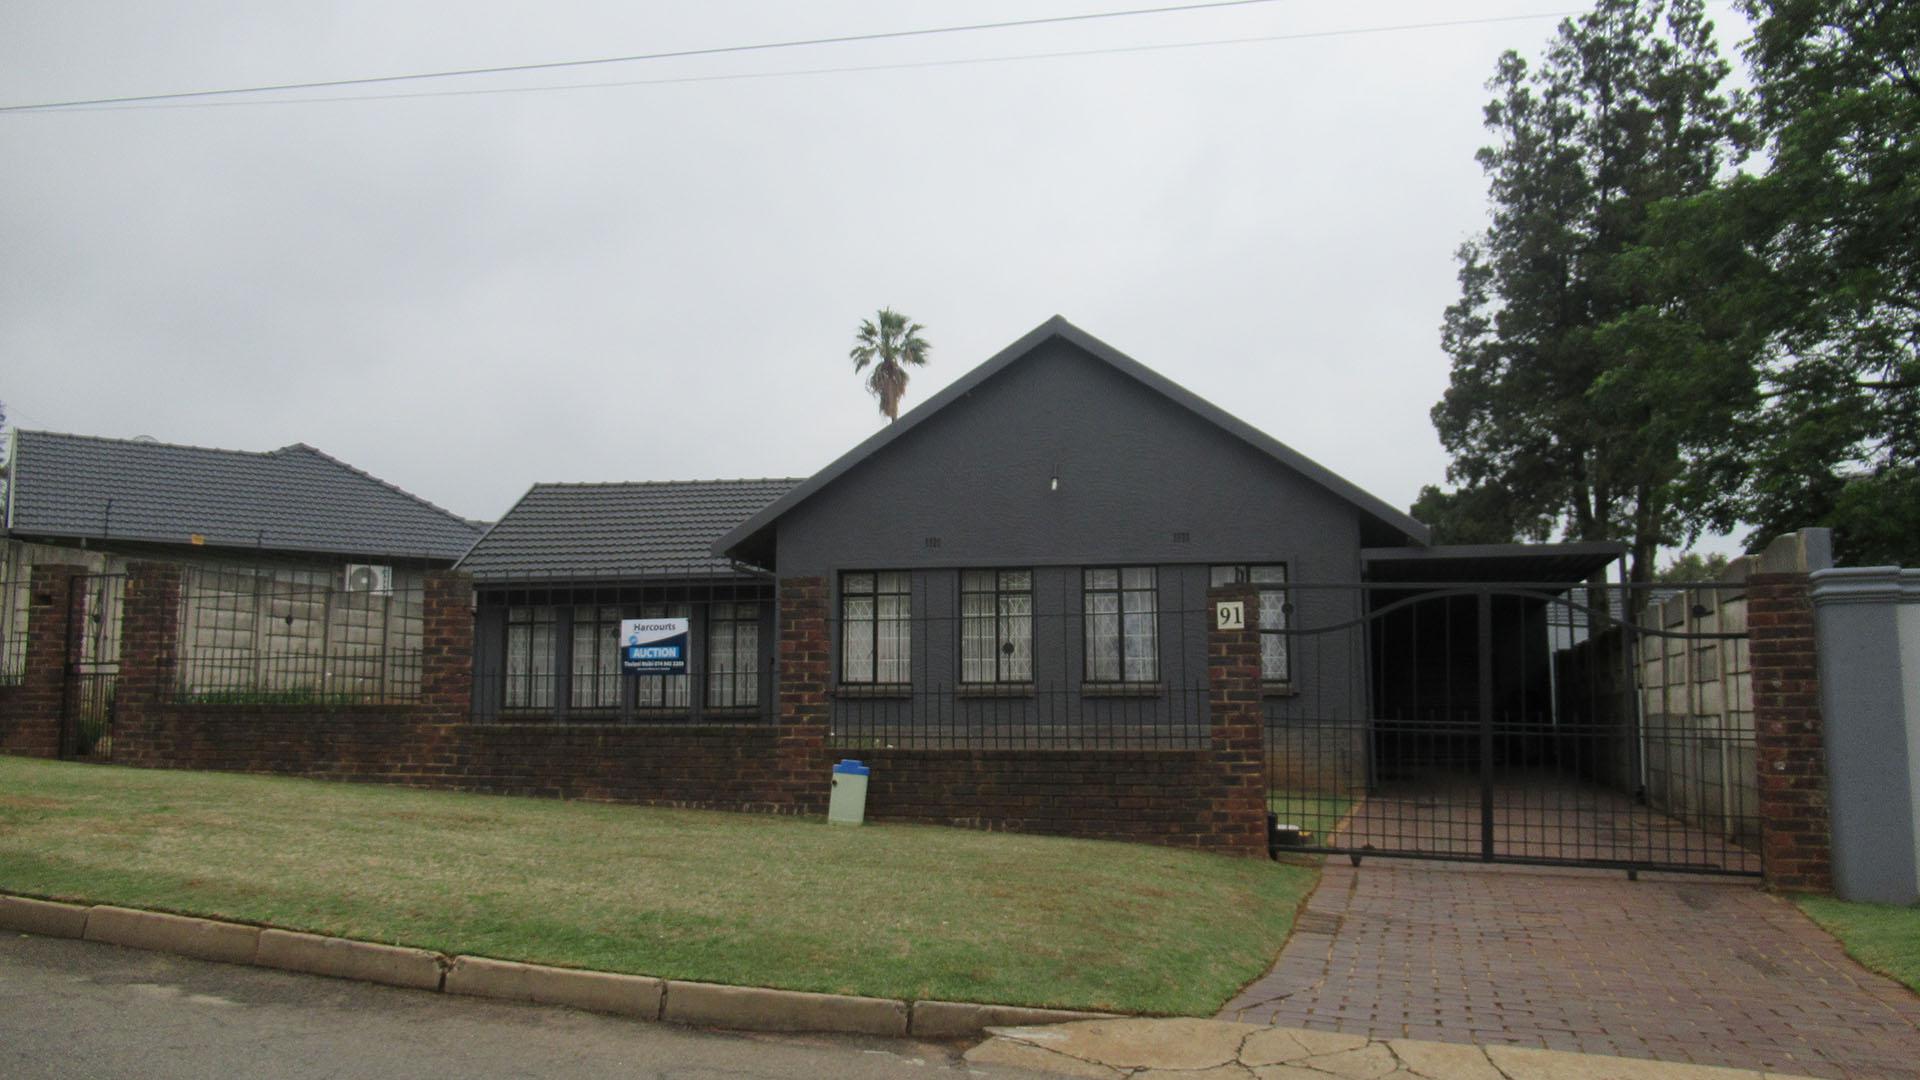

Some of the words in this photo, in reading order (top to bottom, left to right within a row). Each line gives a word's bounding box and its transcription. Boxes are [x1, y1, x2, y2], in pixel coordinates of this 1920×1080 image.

[1220, 606, 1242, 625] 91
[633, 623, 676, 632] Harcourts
[633, 647, 676, 658] AUCTION
